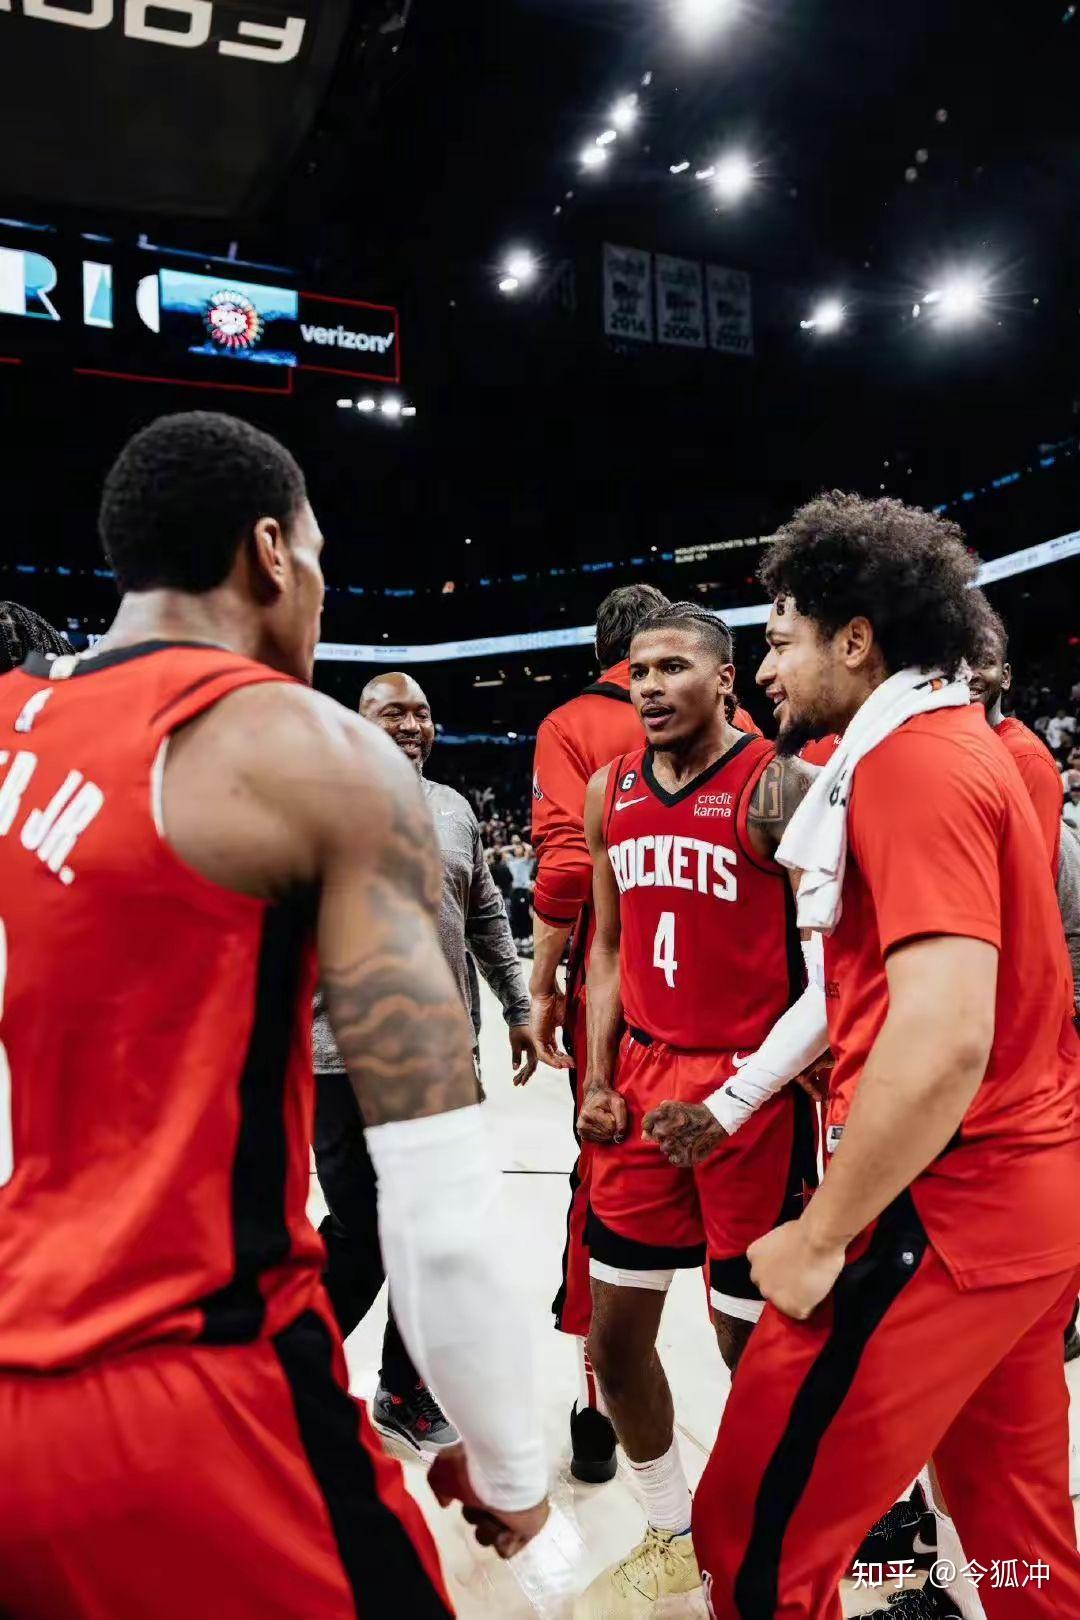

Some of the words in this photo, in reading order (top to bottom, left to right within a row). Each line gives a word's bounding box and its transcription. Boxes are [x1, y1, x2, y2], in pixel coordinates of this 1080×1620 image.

[610, 312, 646, 335] 2014
[300, 323, 394, 353] verizon
[622, 773, 634, 790] 6
[698, 792, 732, 805] credit
[693, 804, 731, 818] karma
[607, 834, 738, 903] ROCKETS
[653, 911, 678, 989] 4
